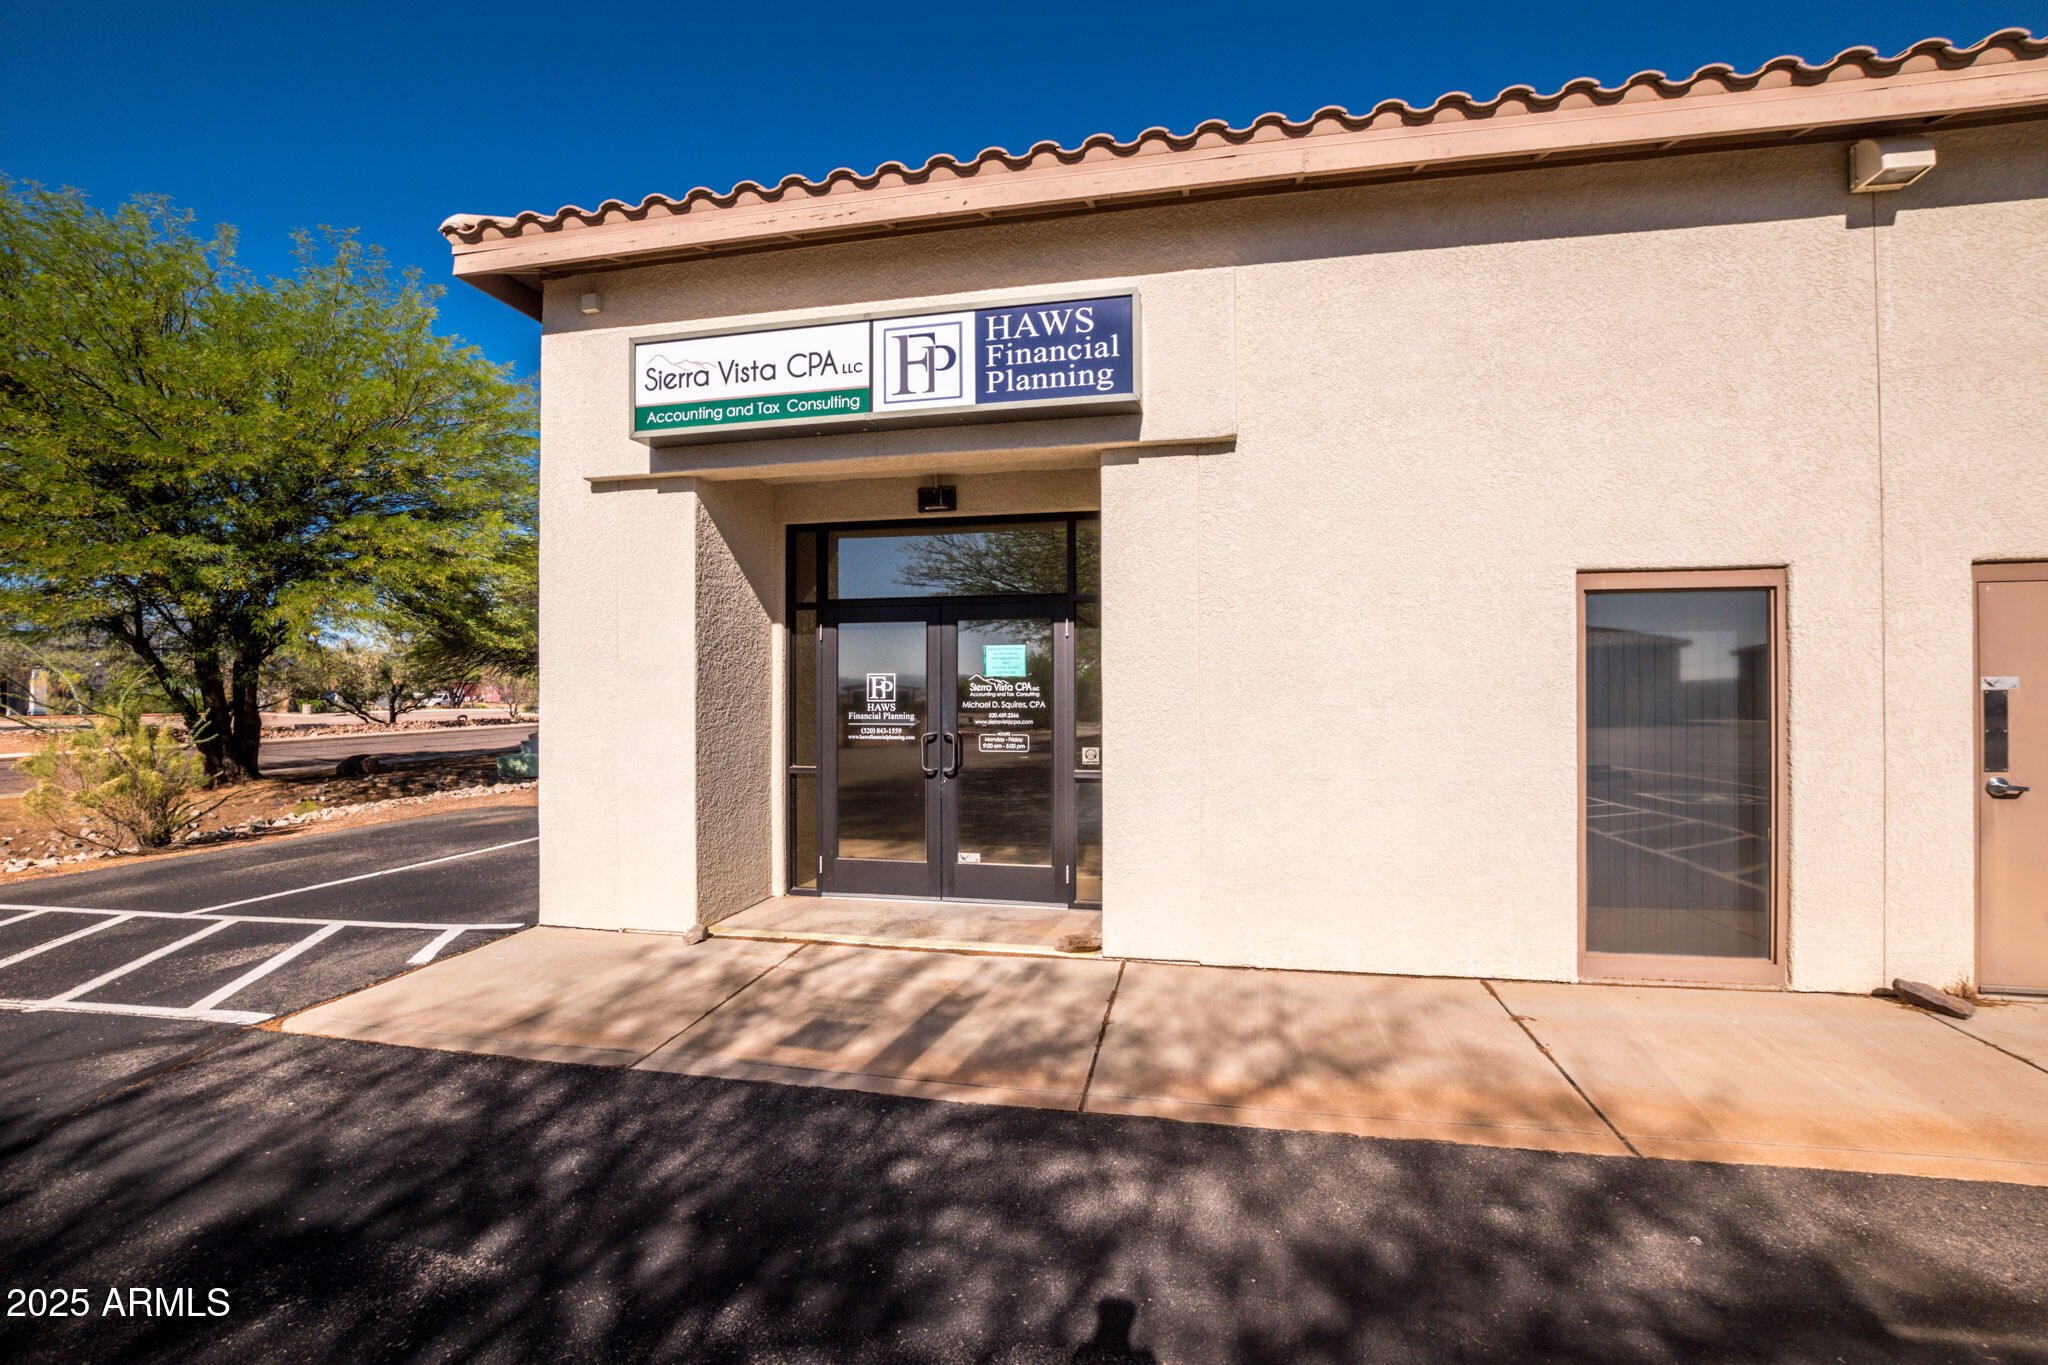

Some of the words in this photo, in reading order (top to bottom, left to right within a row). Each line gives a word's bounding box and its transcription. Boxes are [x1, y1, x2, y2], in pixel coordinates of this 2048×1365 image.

[985, 306, 1095, 342] HAWS
[985, 334, 1121, 367] Financial
[644, 366, 710, 392] Sierra
[718, 359, 777, 385] Vista
[787, 349, 839, 379] CPA
[842, 362, 864, 374] LLC
[985, 363, 1114, 393] Planning
[646, 405, 723, 425] Accounting
[726, 400, 754, 417] and
[757, 400, 780, 415] Tax
[786, 395, 861, 413] Consulting
[969, 682, 993, 692] Sierra
[994, 682, 1014, 692] Vista
[1015, 682, 1032, 692] CPA
[848, 712, 881, 720] Financial
[883, 712, 915, 721] Planning
[867, 703, 896, 712] HAWS
[962, 701, 991, 709] Michael
[992, 701, 999, 709] D.
[1001, 701, 1028, 710] Squires,
[1029, 701, 1046, 709] CPA
